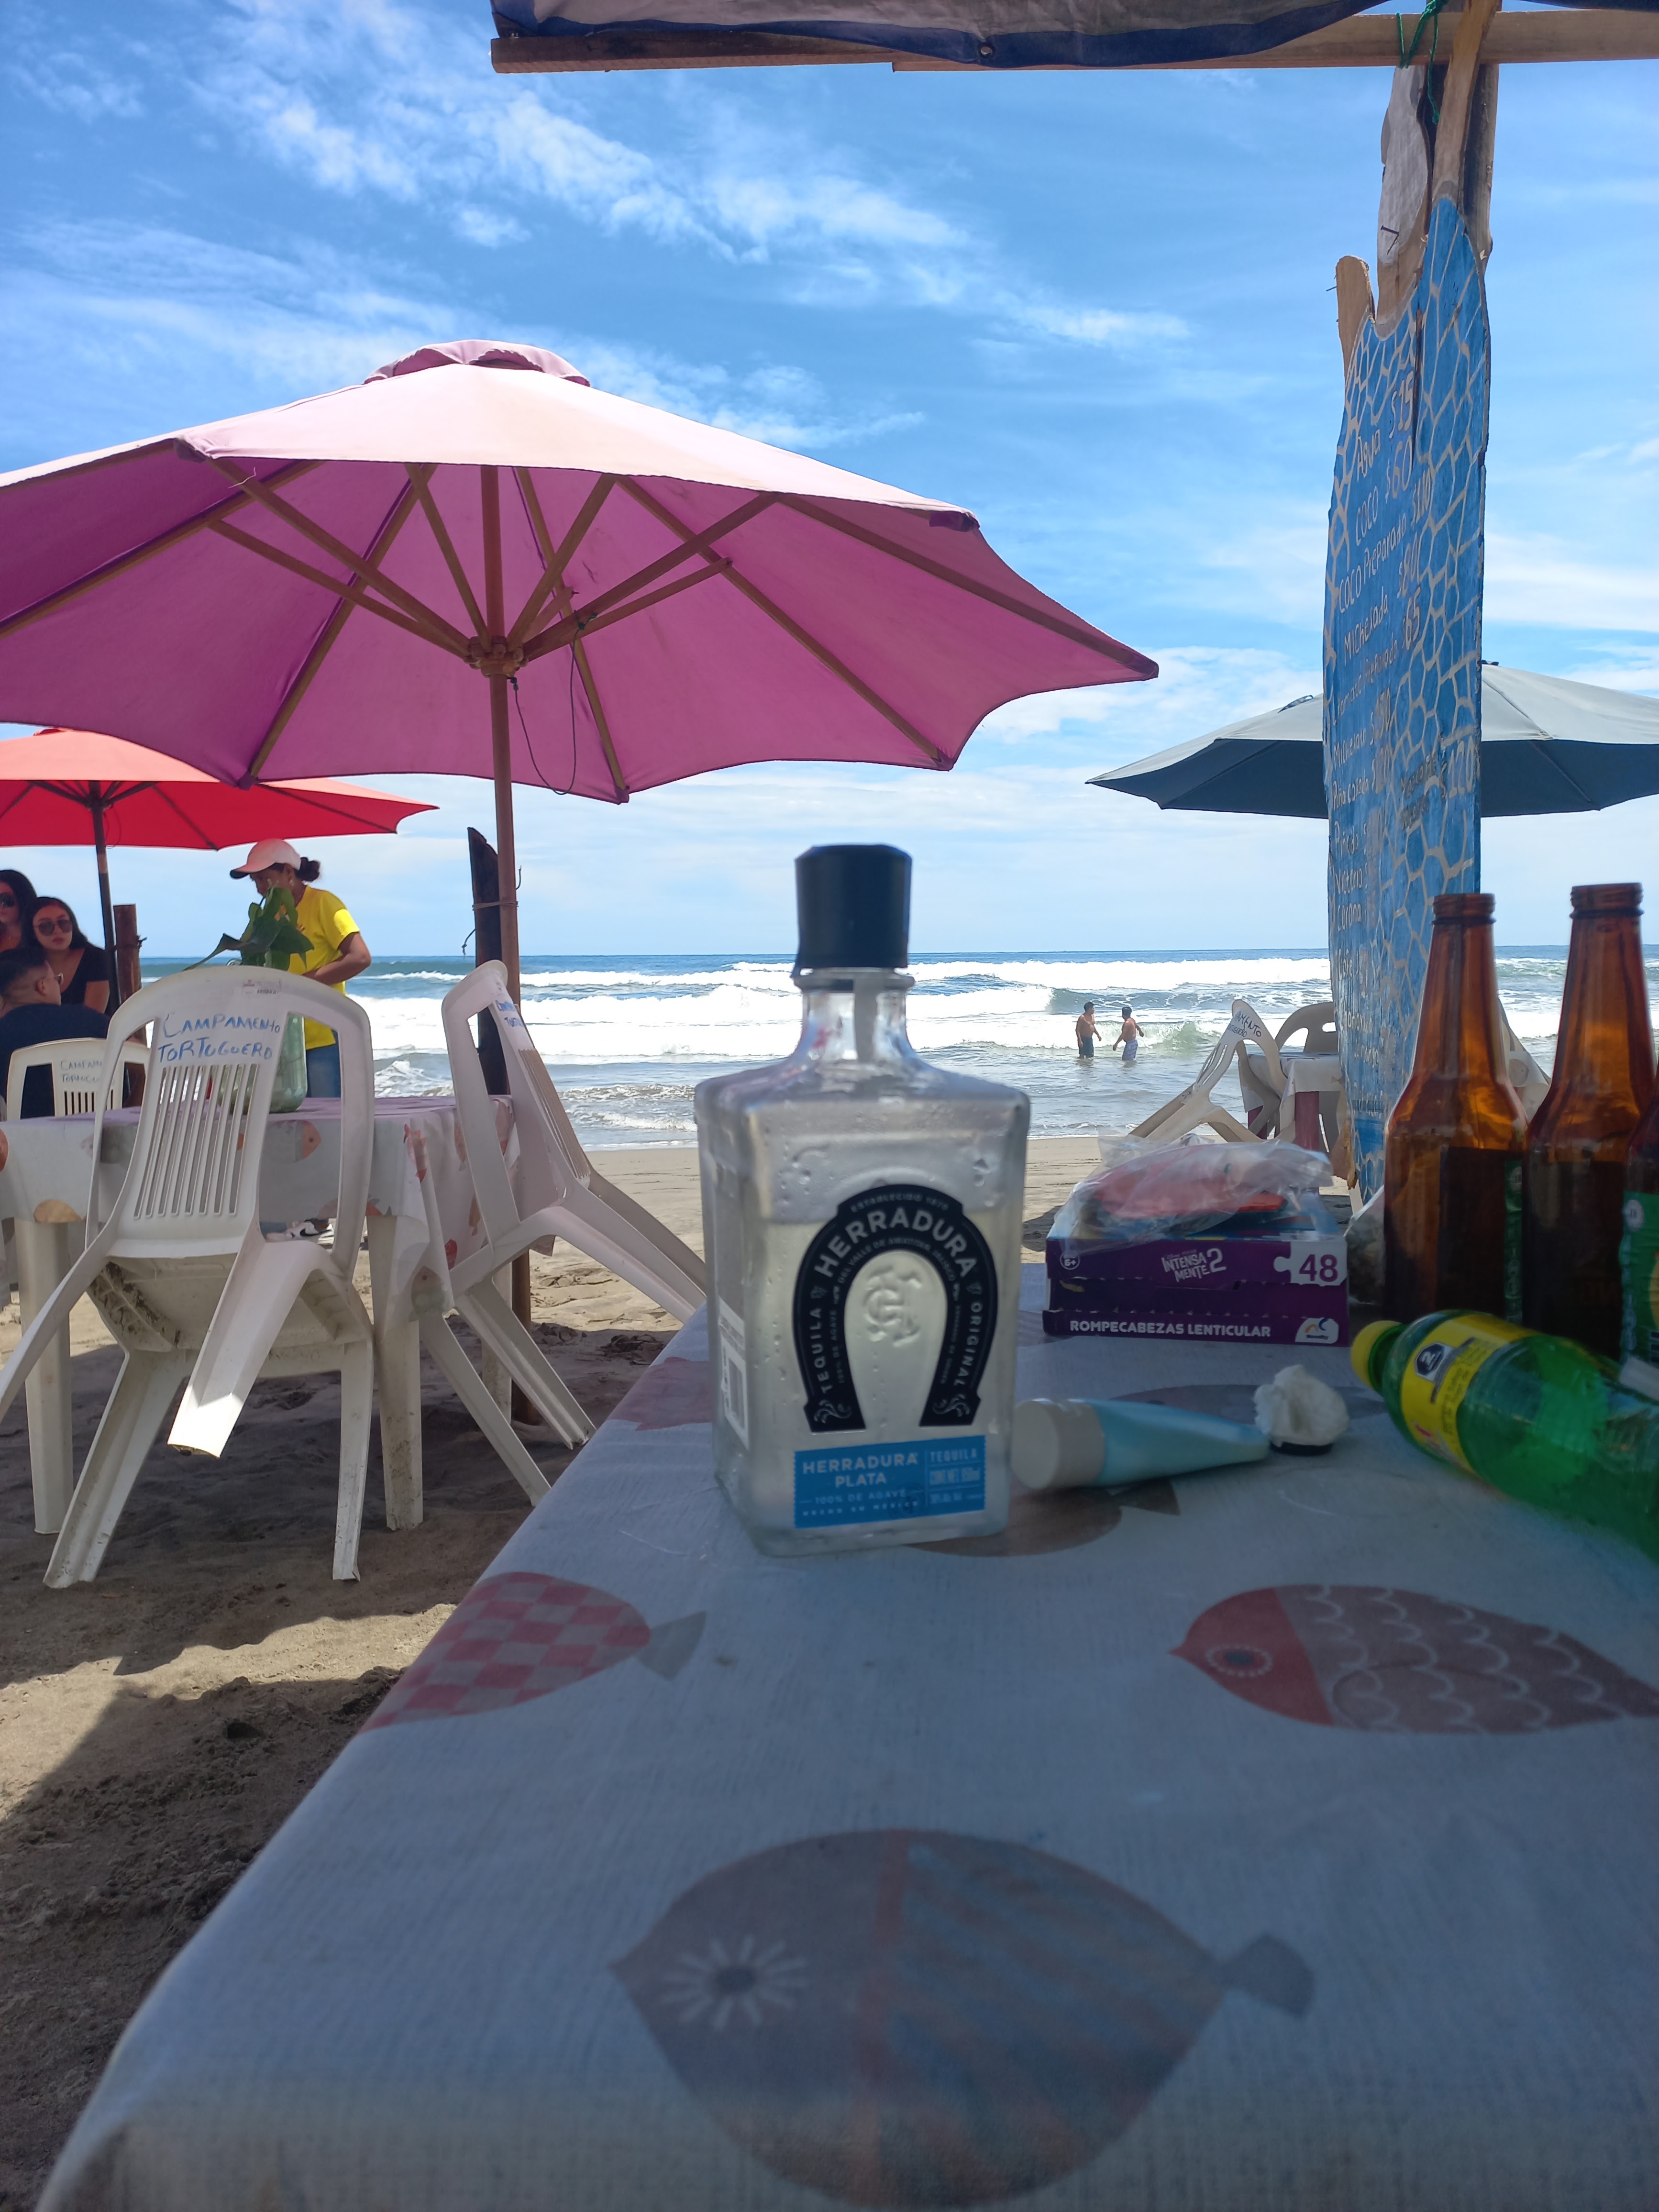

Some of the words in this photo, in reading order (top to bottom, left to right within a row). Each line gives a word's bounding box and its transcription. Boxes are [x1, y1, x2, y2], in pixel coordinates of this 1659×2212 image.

[1357, 429, 1381, 482] Agua
[1356, 486, 1378, 546] COCO
[1385, 434, 1411, 505] $60
[1339, 564, 1362, 613] COCO
[1364, 513, 1406, 585] Preparado
[1337, 903, 1362, 932] Corona
[157, 1036, 273, 1063] TORTUGUERO
[814, 1206, 977, 1278] HERRADURA
[1161, 1252, 1206, 1272] INTENSA
[1206, 1248, 1227, 1272] 2
[1174, 1264, 1210, 1283] MENTE
[1299, 1254, 1338, 1283] 48
[953, 1301, 983, 1386] ORIGINAL
[1070, 1320, 1184, 1334] ROMPECABEZAS
[1187, 1324, 1272, 1338] LENTICULAR
[809, 1307, 833, 1394] TEQUILA
[803, 1452, 918, 1475] HERRADURA
[929, 1447, 977, 1463] TEQUILA
[835, 1472, 887, 1488] PLATA
